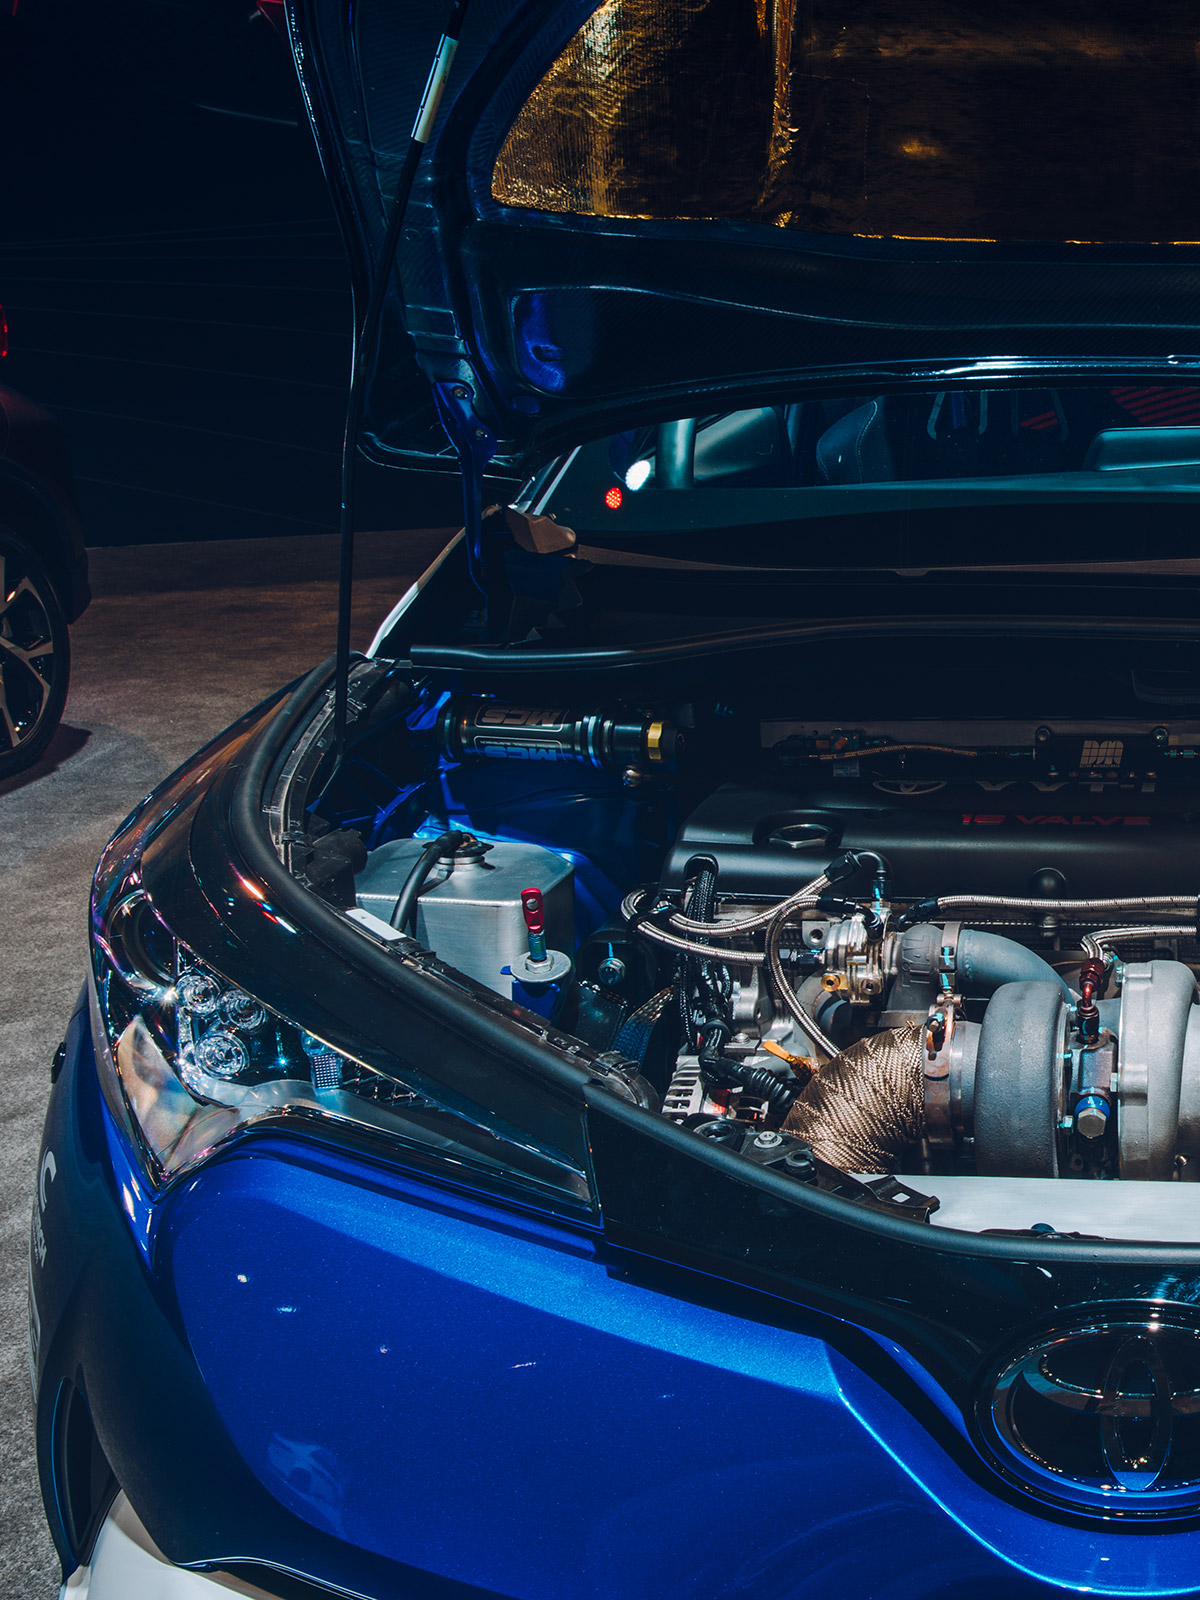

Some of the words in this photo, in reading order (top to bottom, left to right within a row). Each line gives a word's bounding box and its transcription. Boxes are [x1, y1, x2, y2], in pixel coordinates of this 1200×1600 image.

[481, 708, 561, 727] MCS
[484, 745, 557, 761] MCS
[961, 814, 1007, 825] 16
[1016, 815, 1152, 825] VALVE
